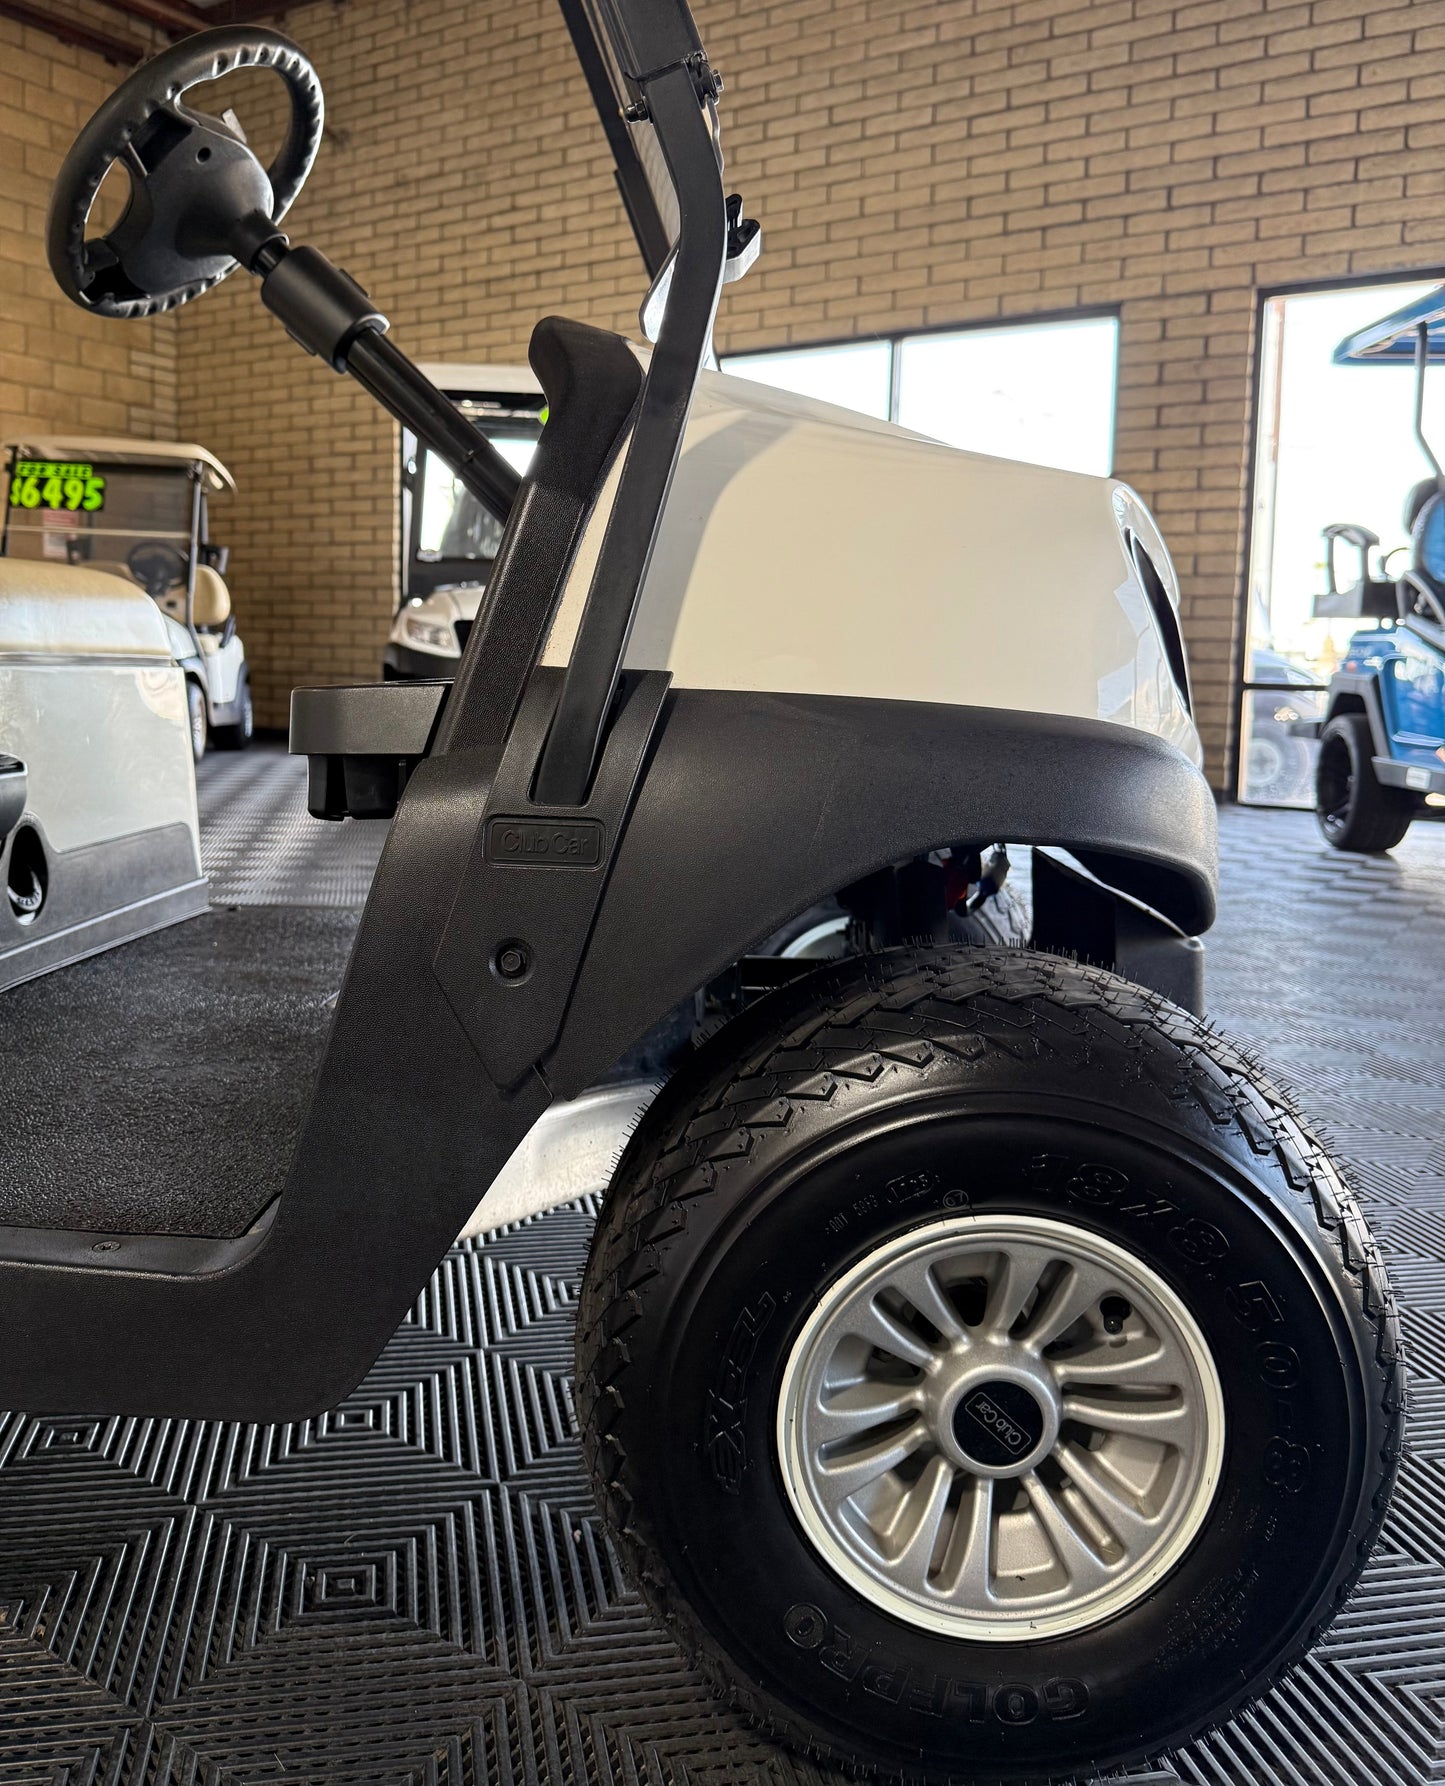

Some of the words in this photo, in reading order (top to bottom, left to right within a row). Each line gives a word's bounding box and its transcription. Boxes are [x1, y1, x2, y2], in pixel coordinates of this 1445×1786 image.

[10, 477, 105, 511] $6495
[501, 829, 550, 854] Club
[551, 831, 589, 857] Car
[975, 1401, 998, 1424] Car
[995, 1418, 1022, 1446] Club
